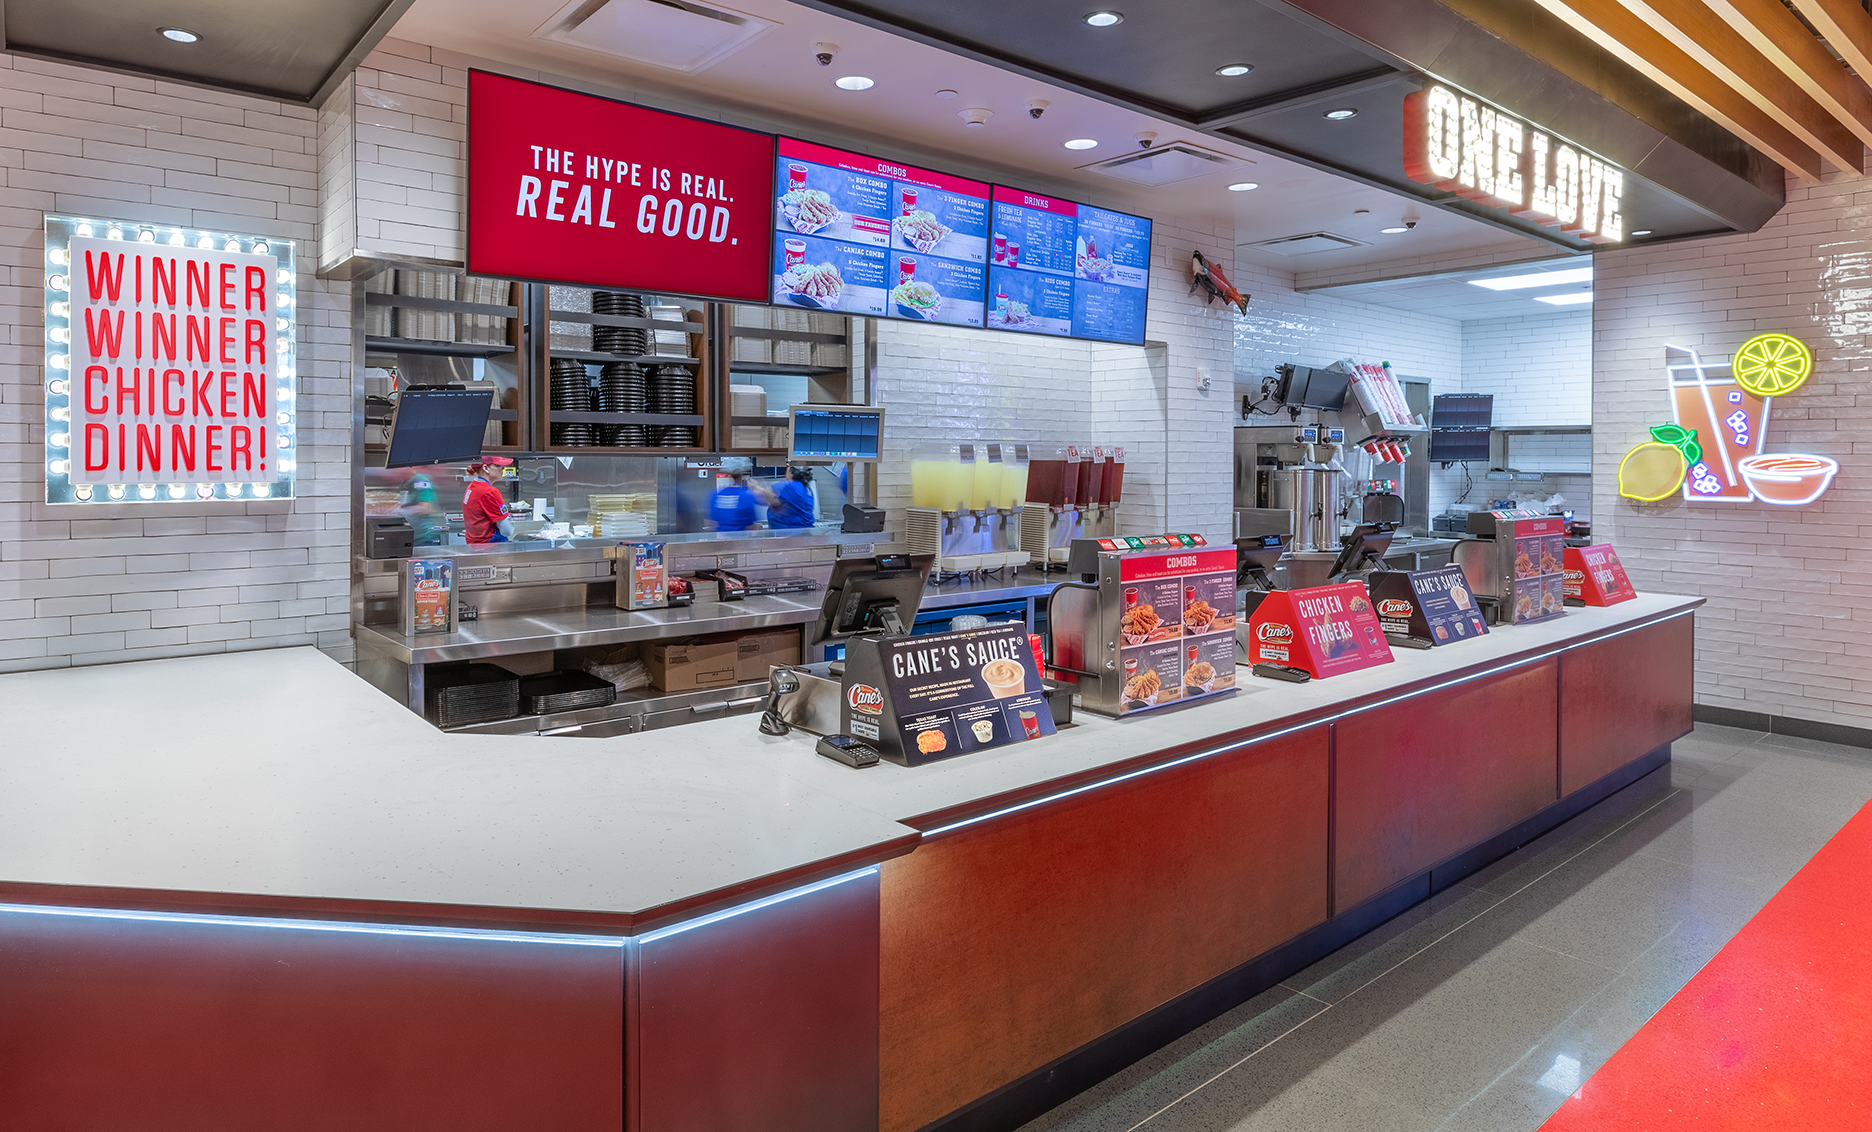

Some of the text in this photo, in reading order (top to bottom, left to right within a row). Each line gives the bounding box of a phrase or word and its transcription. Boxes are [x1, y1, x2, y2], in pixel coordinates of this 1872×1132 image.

[878, 163, 906, 177] COMBOS
[1428, 86, 1622, 242] ONE LOVE
[530, 145, 734, 202] THE HYPE IS REAL.
[868, 180, 887, 189] COMBO
[516, 175, 738, 246] REAL GOOD.
[968, 201, 984, 209] COMBO
[1024, 196, 1048, 208] DRINKS
[866, 250, 884, 258] COMBO
[84, 250, 266, 312] WINNER
[84, 307, 266, 365] WINNER
[84, 365, 266, 418] CHICKEN
[84, 422, 266, 472] DINNER!
[1166, 556, 1197, 569] COMBOS
[1586, 552, 1606, 566] CHICKEN
[1563, 570, 1584, 580] ane's
[1594, 569, 1615, 584] FINGERS
[1414, 576, 1441, 594] CANE'S
[1299, 595, 1343, 618] CHICKEN
[1380, 600, 1413, 616] Cane's
[1259, 622, 1293, 640] Cane's
[1309, 620, 1353, 644] FINGERS
[893, 646, 960, 678] CANE'S
[850, 684, 883, 708] Cane's
